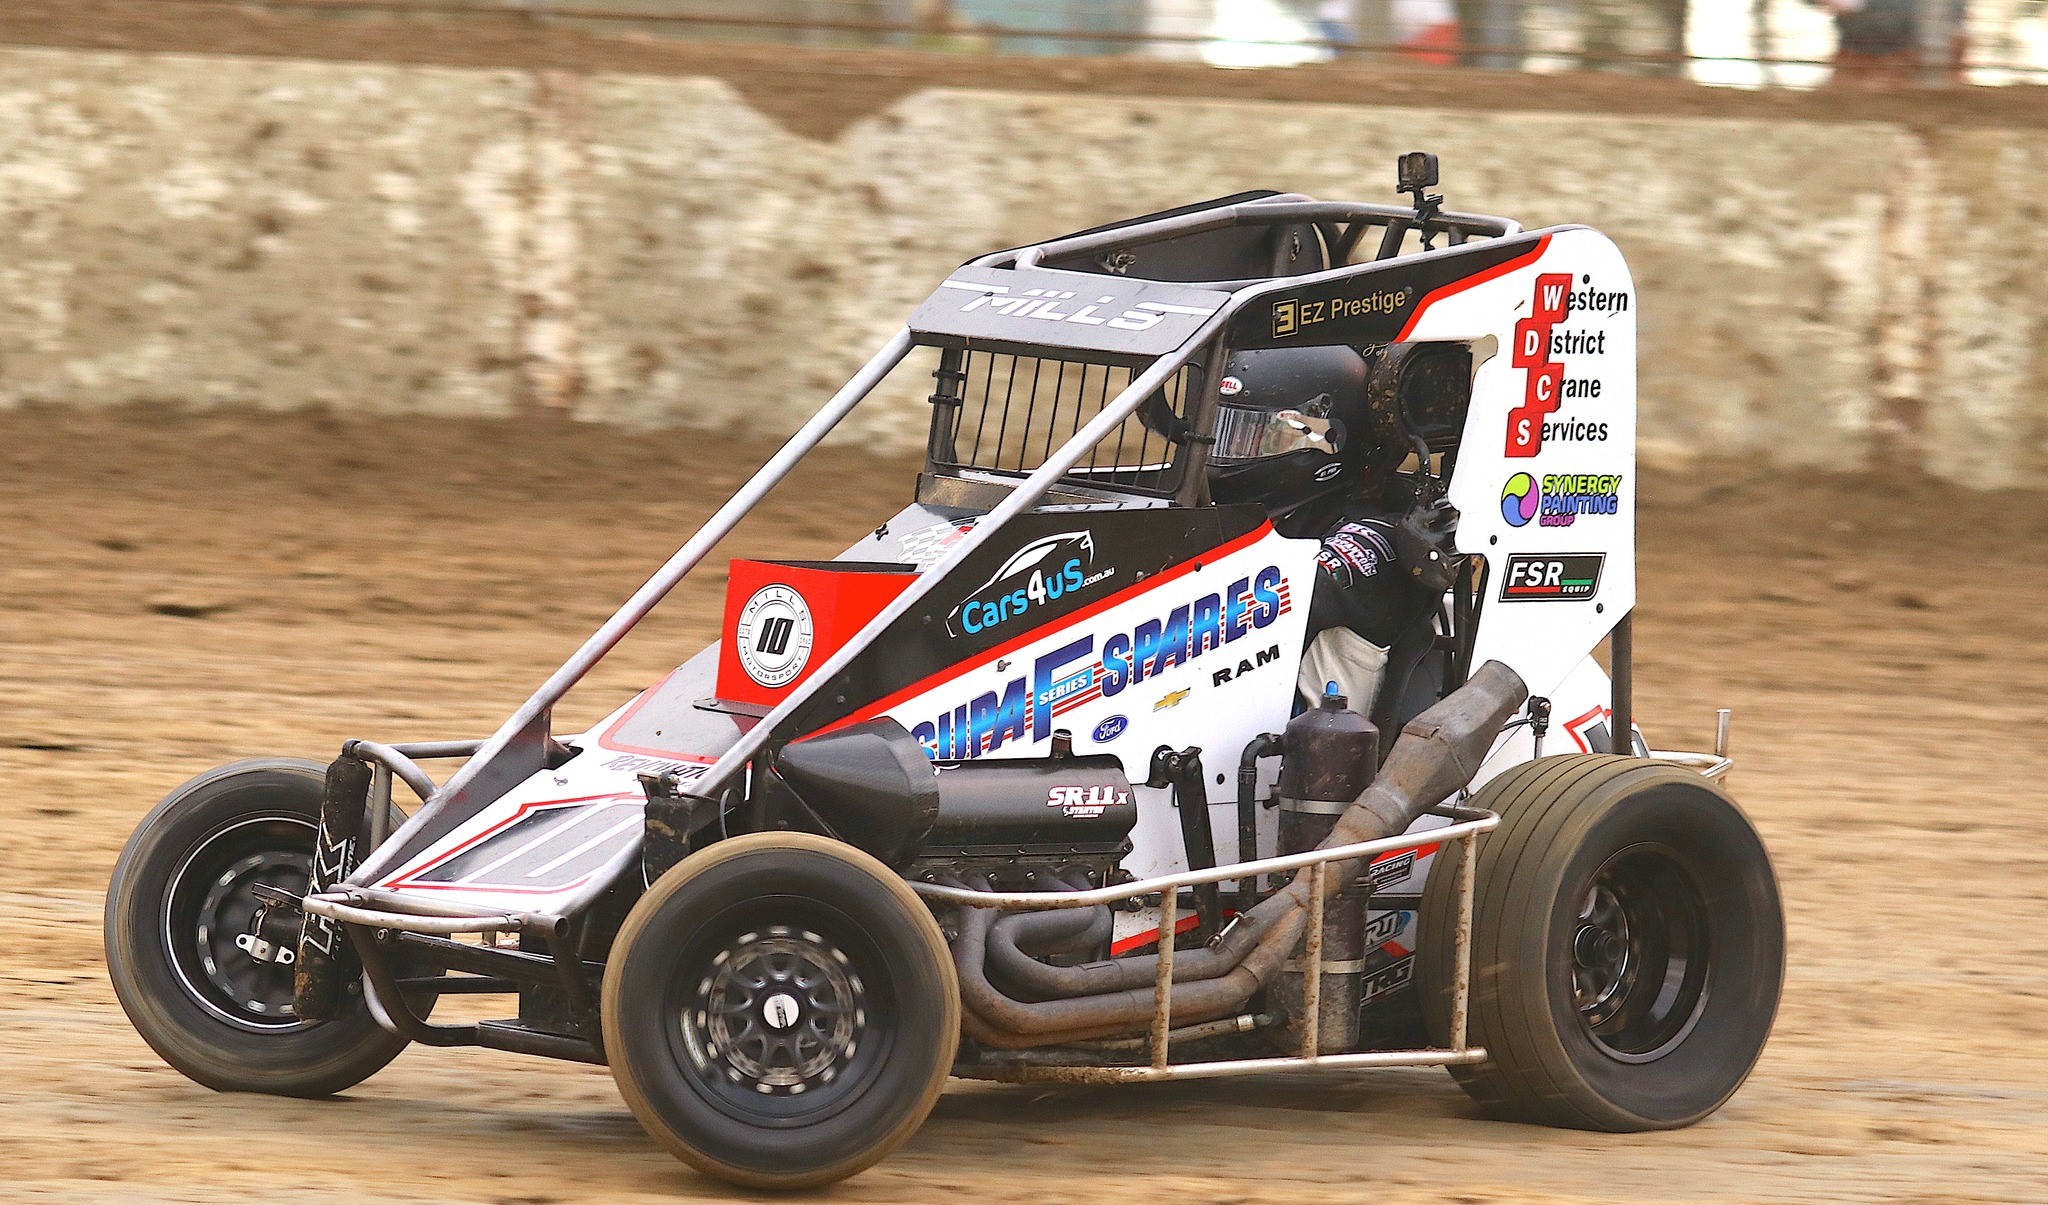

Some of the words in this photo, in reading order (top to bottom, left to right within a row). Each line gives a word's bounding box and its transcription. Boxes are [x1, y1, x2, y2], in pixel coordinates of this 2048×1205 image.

[948, 282, 1195, 332] MILLS
[1300, 301, 1325, 326] EZ
[1331, 289, 1407, 320] Prestige
[1543, 284, 1629, 312] Western
[1523, 329, 1606, 356] District
[1536, 374, 1602, 402] Crane
[1515, 417, 1609, 447] Services
[1541, 474, 1622, 495] SYNERGY
[1540, 495, 1619, 515] PAINTING
[1539, 514, 1576, 527] GROUP
[1508, 561, 1565, 588] FSR
[1561, 585, 1591, 594] EQUIP
[748, 589, 807, 622] MILLS
[756, 616, 795, 656] 10
[1102, 565, 1281, 698] SPARES
[742, 645, 803, 682] MOTORSPORT
[1212, 644, 1281, 688] RAM
[1033, 634, 1094, 744] F
[1039, 674, 1089, 708] SERIES
[1370, 857, 1411, 877] RACING
